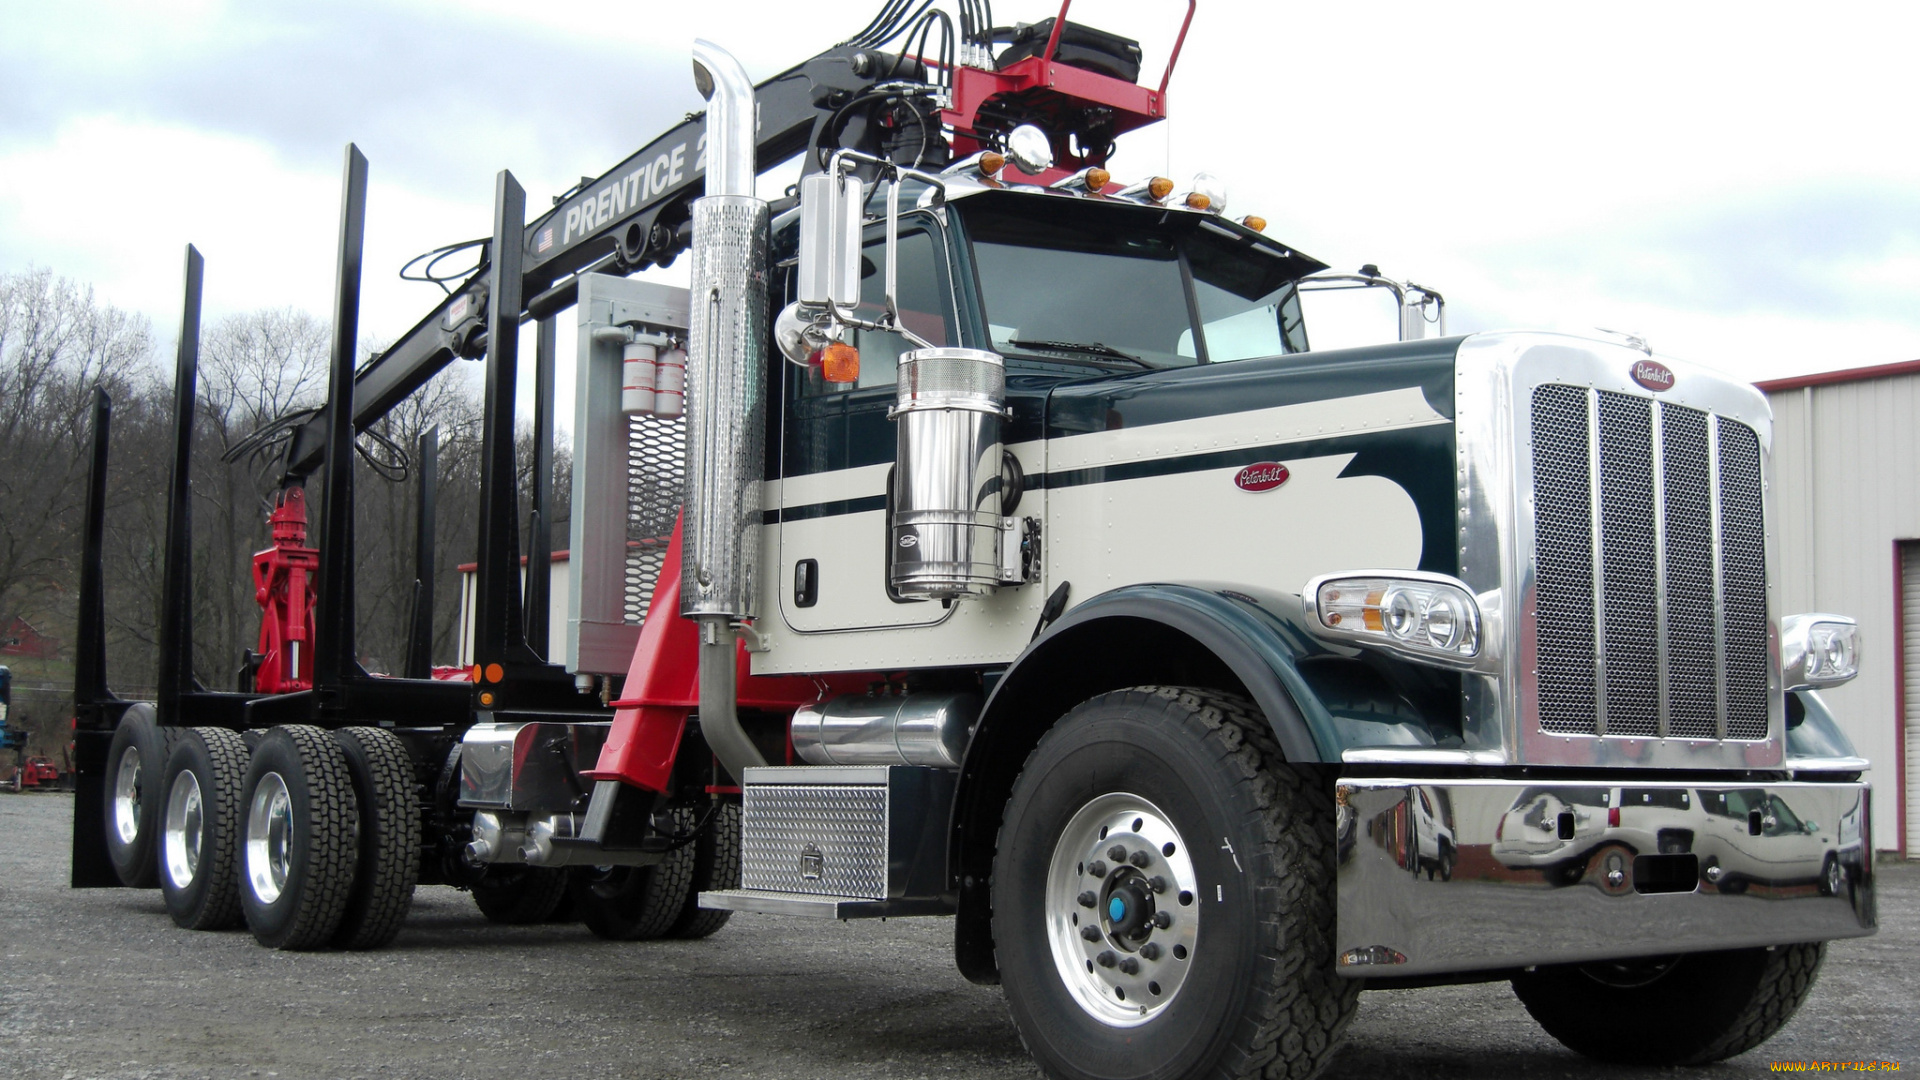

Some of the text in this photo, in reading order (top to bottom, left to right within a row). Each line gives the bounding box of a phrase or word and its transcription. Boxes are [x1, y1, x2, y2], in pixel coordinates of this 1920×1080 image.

[563, 142, 687, 246] PRENTICE
[1637, 362, 1672, 385] Peterbilt
[1240, 467, 1285, 487] Peterbilt
